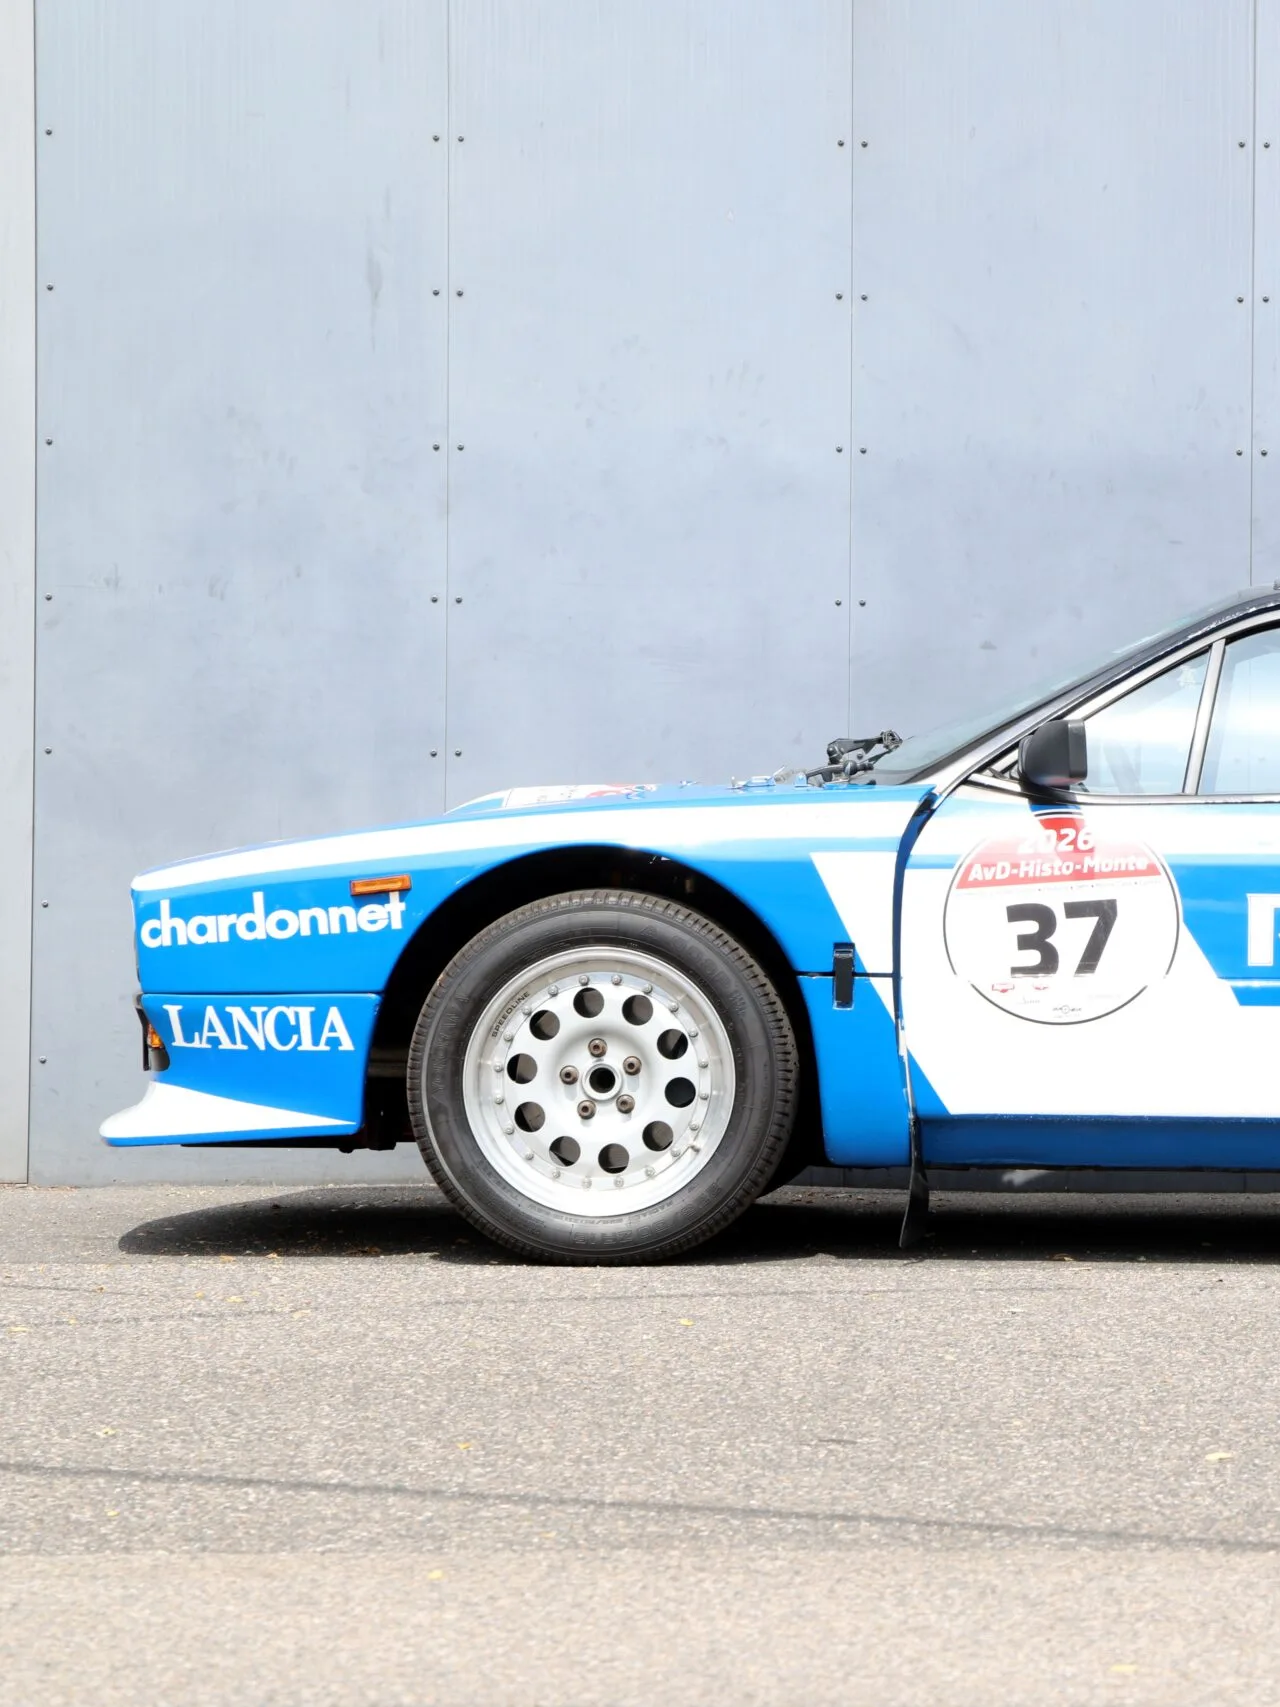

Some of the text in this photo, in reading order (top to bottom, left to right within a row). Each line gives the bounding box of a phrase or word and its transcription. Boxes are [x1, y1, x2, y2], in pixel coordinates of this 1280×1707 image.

[968, 855, 1149, 882] AvD-Histo-Monte
[140, 891, 406, 949] chardonnet
[1006, 899, 1118, 979] 37
[162, 1004, 355, 1051] LANCIA
[491, 991, 531, 1038] SPEEDLINE
